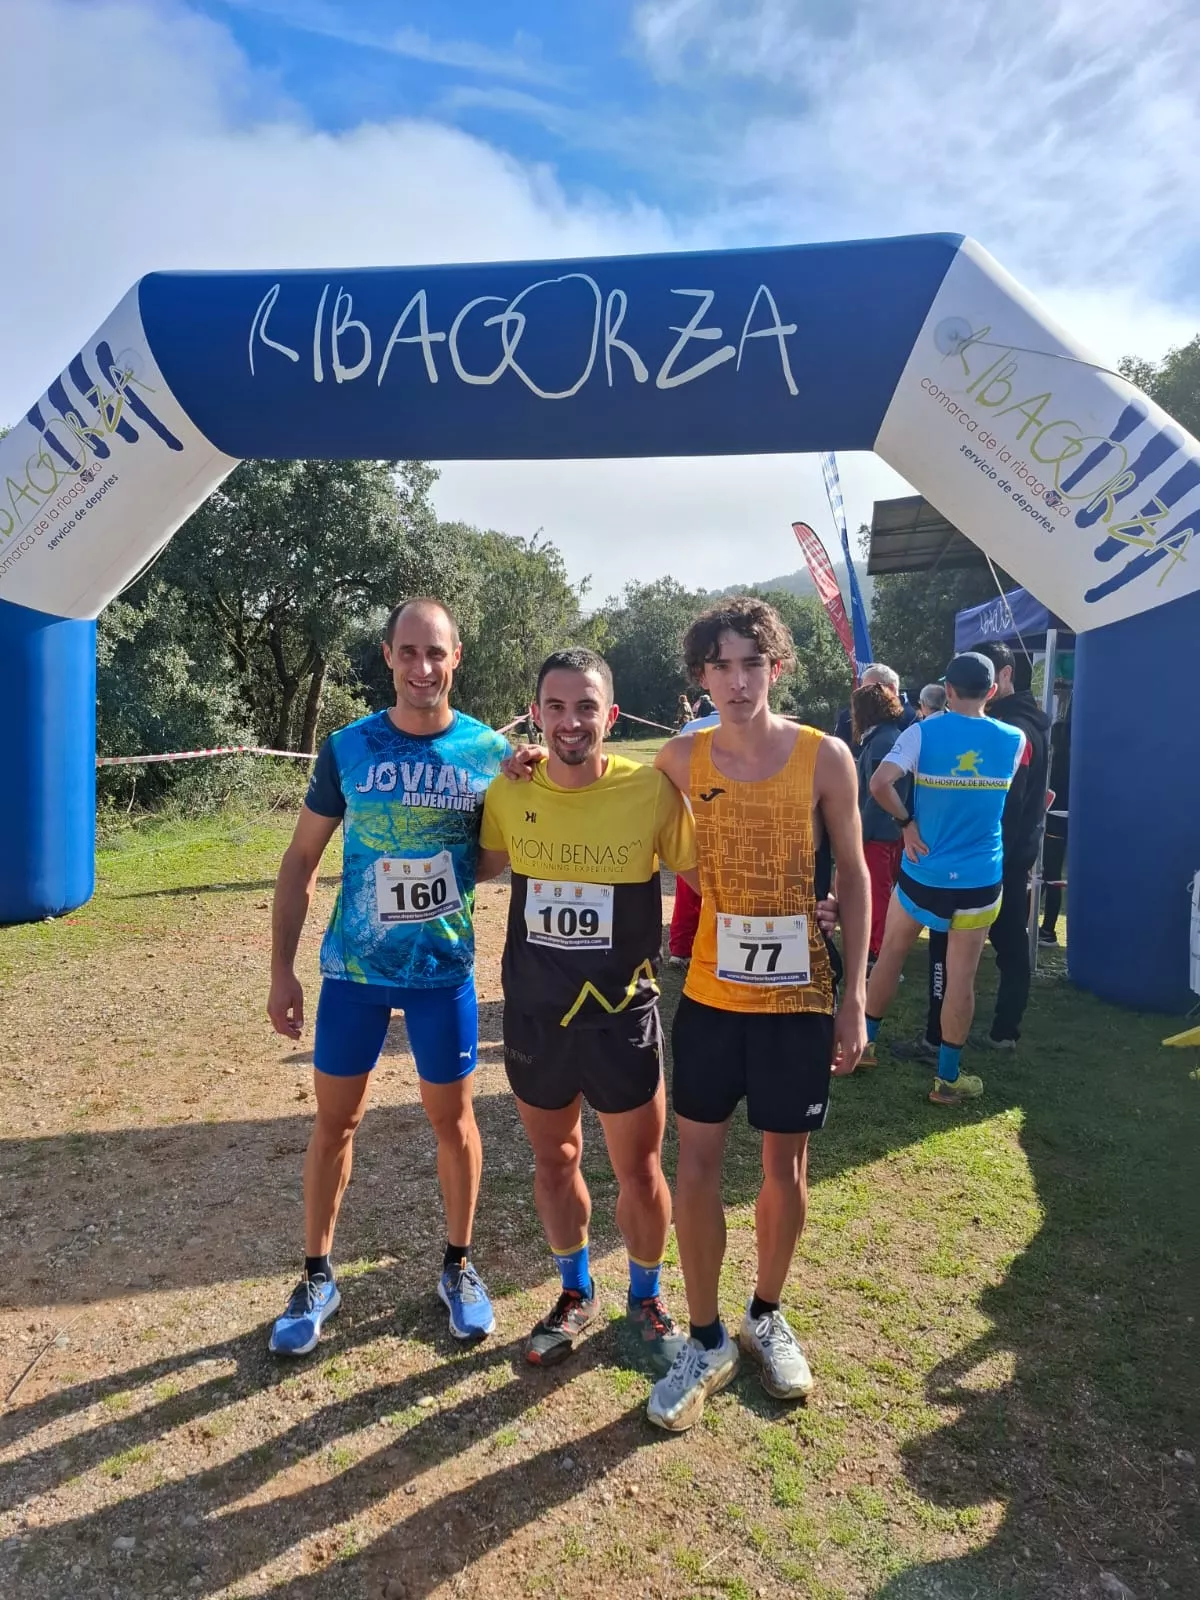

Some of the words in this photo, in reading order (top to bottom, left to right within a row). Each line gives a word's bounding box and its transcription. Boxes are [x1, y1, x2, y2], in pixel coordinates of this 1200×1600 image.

[249, 273, 798, 399] RIBAGORZA
[920, 377, 978, 433] comarca
[977, 431, 997, 450] de
[996, 444, 1012, 464] la
[941, 326, 1194, 587] RIBAGORZA
[959, 444, 997, 480] servicio
[997, 478, 1012, 493] de
[1012, 491, 1056, 533] deportes
[47, 520, 76, 550] servicio
[74, 508, 87, 521] de
[85, 473, 119, 509] deportes
[0, 534, 35, 578] omarca
[33, 520, 49, 536] de
[48, 508, 60, 522] la
[355, 761, 477, 798] JOVIAL
[934, 778, 967, 787] HOSPITAL
[968, 779, 978, 787] DE
[401, 792, 477, 812] ADVENTURE
[511, 835, 554, 861] MON
[391, 877, 446, 910] 160
[538, 906, 599, 936] 109
[739, 942, 782, 972] 77
